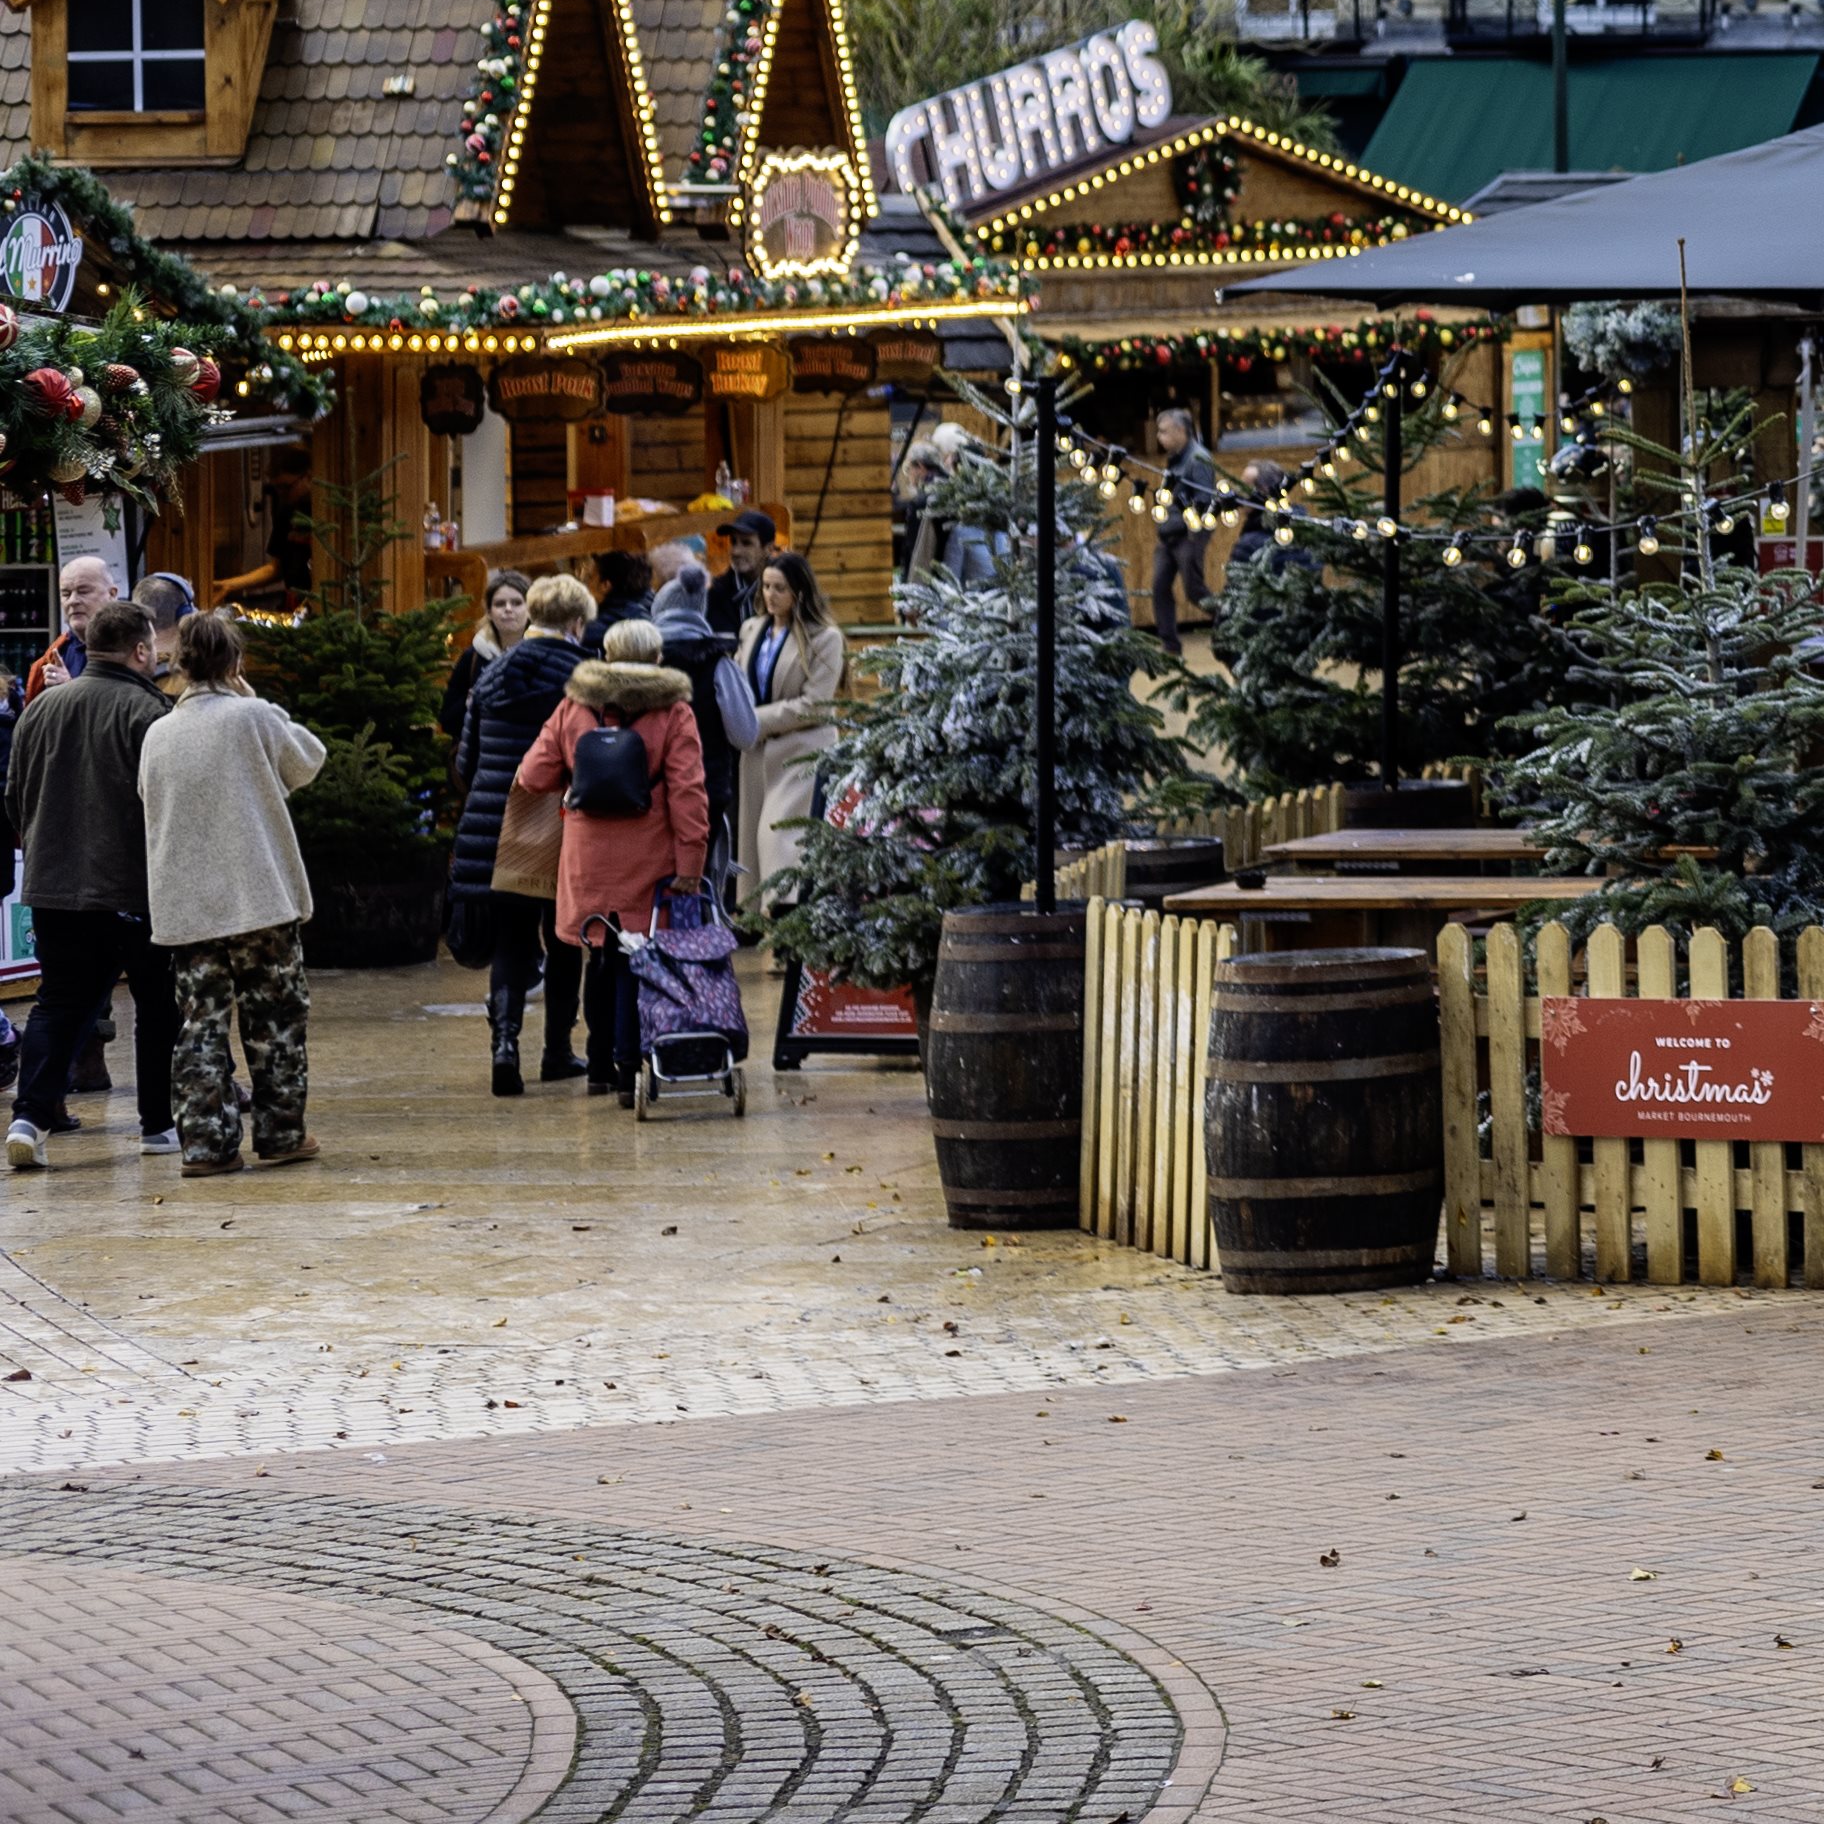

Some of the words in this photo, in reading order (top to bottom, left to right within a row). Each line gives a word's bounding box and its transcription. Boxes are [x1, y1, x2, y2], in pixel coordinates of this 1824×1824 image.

[885, 19, 1173, 210] CHURROS
[1655, 1037, 1712, 1048] WELCOME
[1715, 1038, 1731, 1049] TO
[1615, 1050, 1773, 1105] christmas
[1637, 1110, 1675, 1121] MARKET
[1678, 1111, 1752, 1123] BOURNEMOUTH
